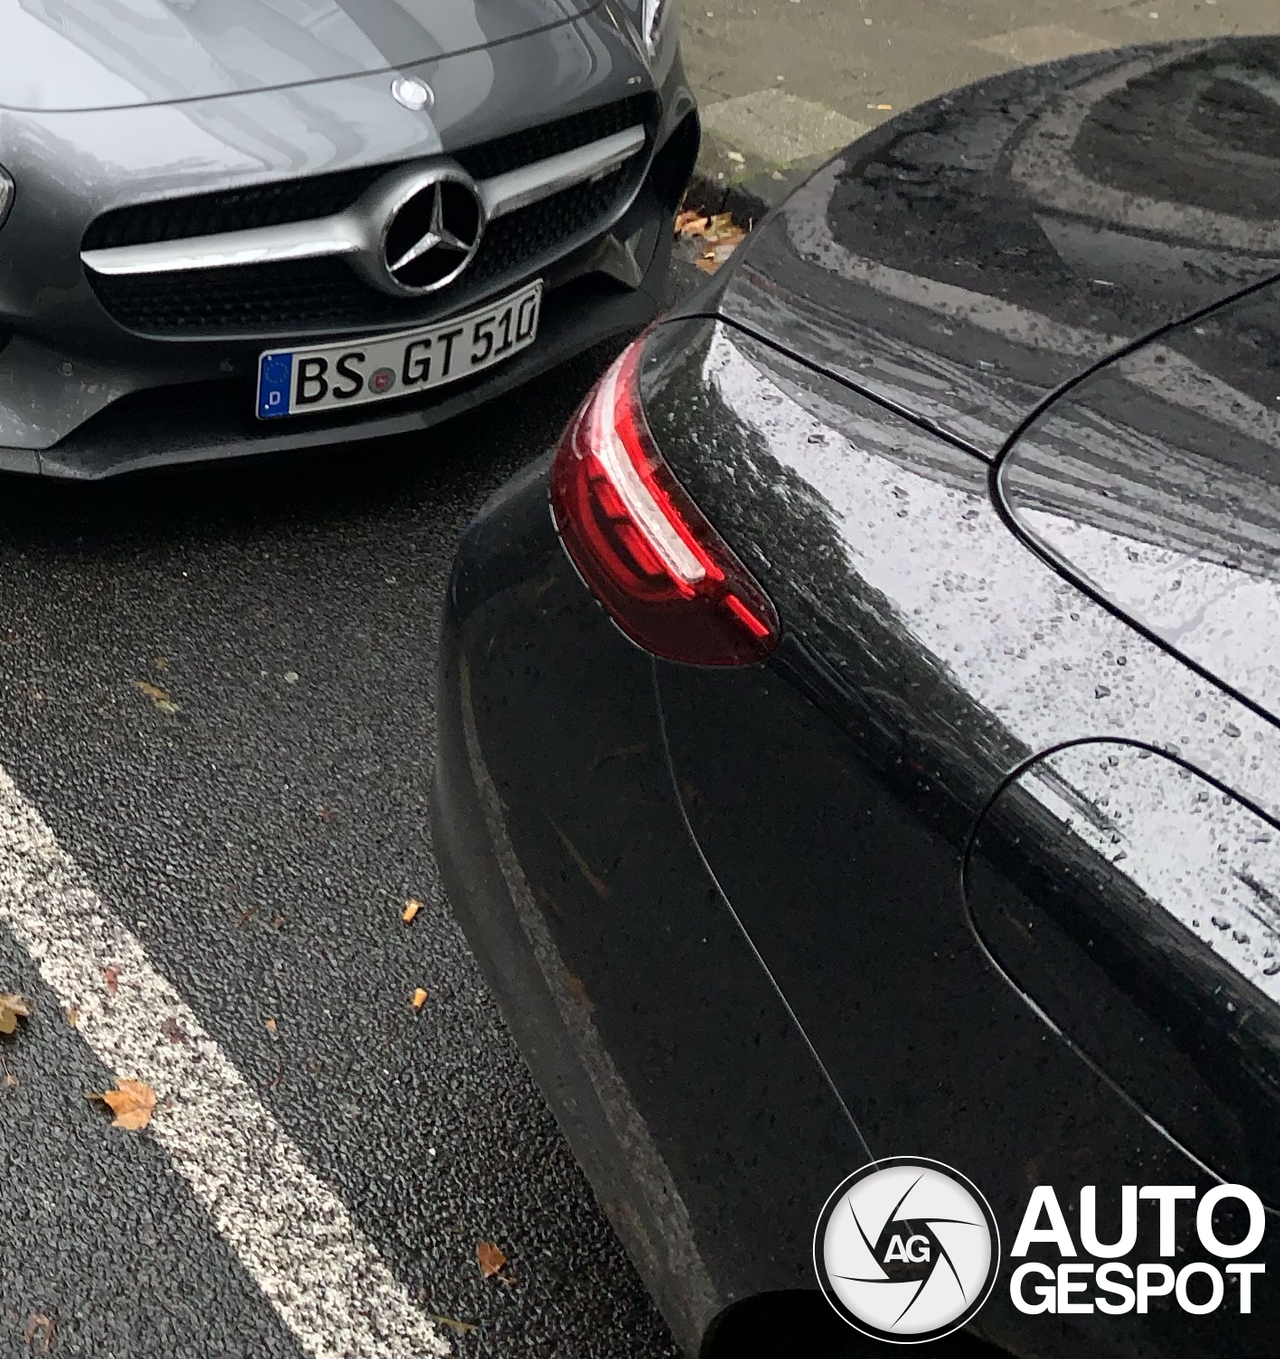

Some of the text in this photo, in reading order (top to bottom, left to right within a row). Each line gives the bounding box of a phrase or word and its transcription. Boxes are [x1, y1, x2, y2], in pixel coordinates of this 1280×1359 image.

[295, 294, 536, 406] BS GT 510
[269, 391, 281, 406] D
